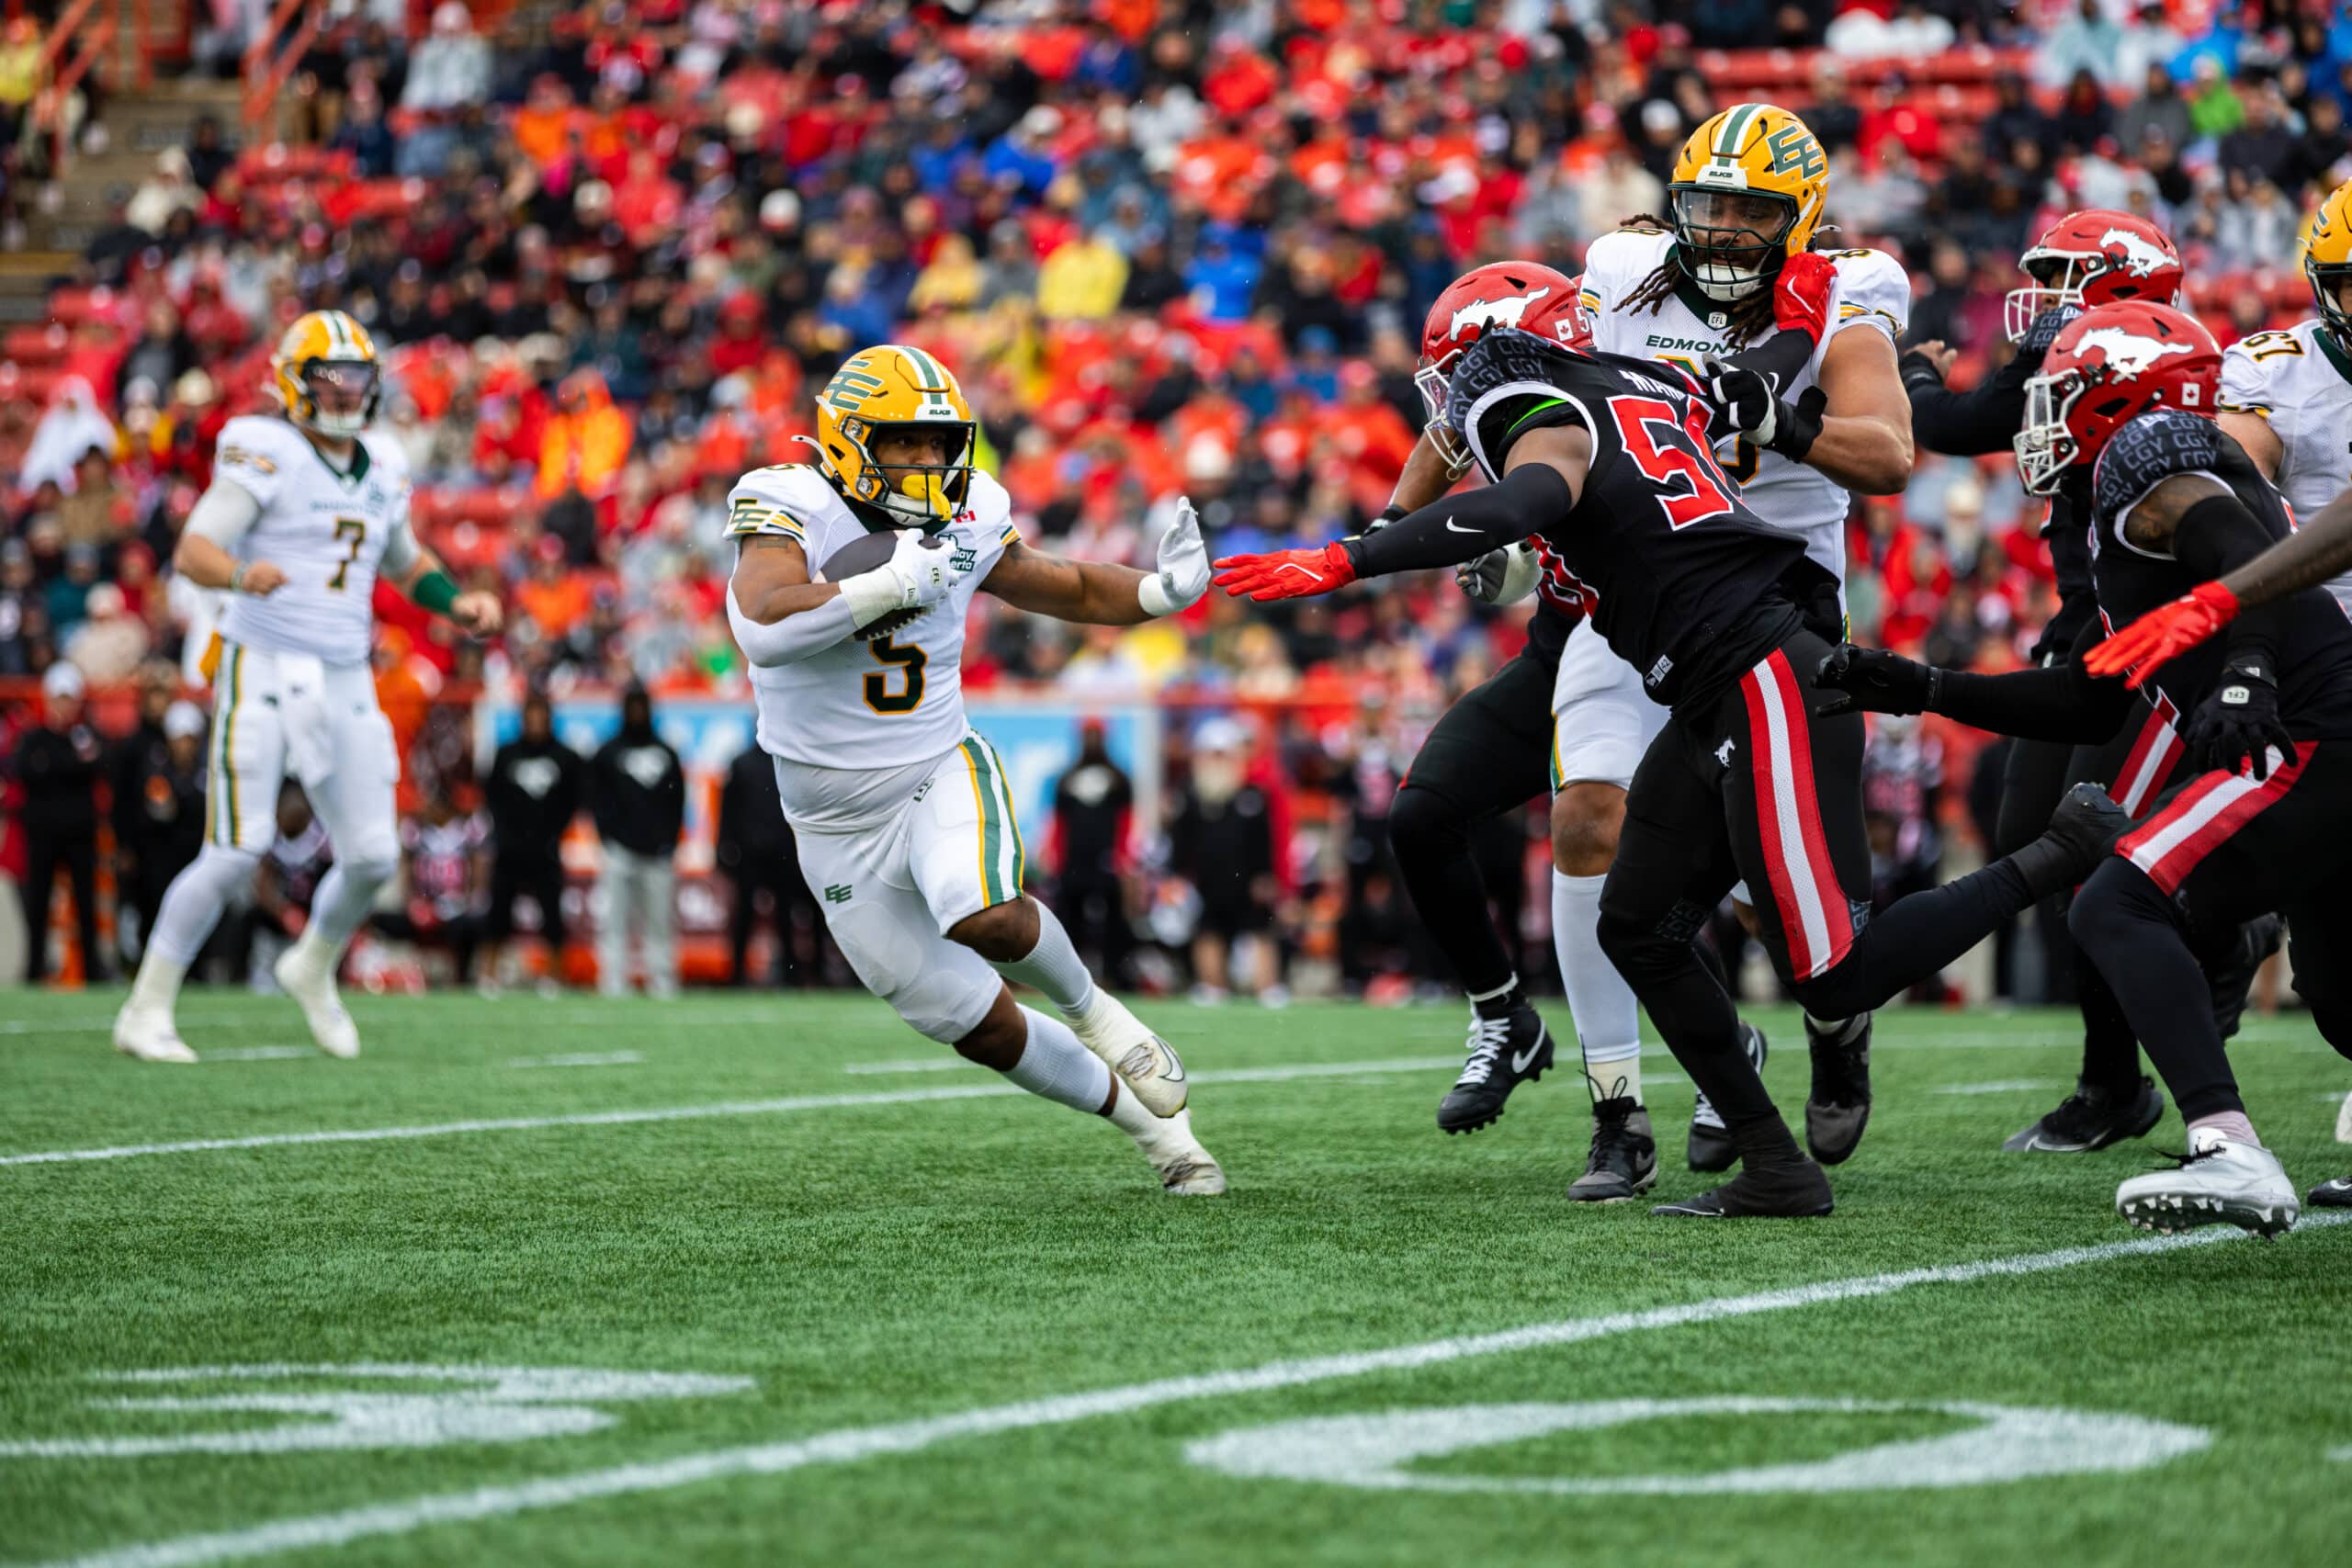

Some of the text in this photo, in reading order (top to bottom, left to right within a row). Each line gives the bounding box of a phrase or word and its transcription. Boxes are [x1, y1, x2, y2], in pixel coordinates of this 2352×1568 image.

[1711, 315, 1724, 325] CFL
[1645, 334, 1740, 355] EDMON
[2244, 332, 2304, 363] 67
[1456, 344, 1492, 378] CGY
[1507, 356, 1545, 375] CGY
[1470, 362, 1505, 390] CGY
[2165, 418, 2204, 431] CGY
[2174, 433, 2211, 448] CGY
[2124, 437, 2163, 469] CGY
[327, 517, 365, 590] 7
[956, 550, 973, 561] lay
[862, 632, 928, 716] 5
[824, 884, 853, 904] EE
